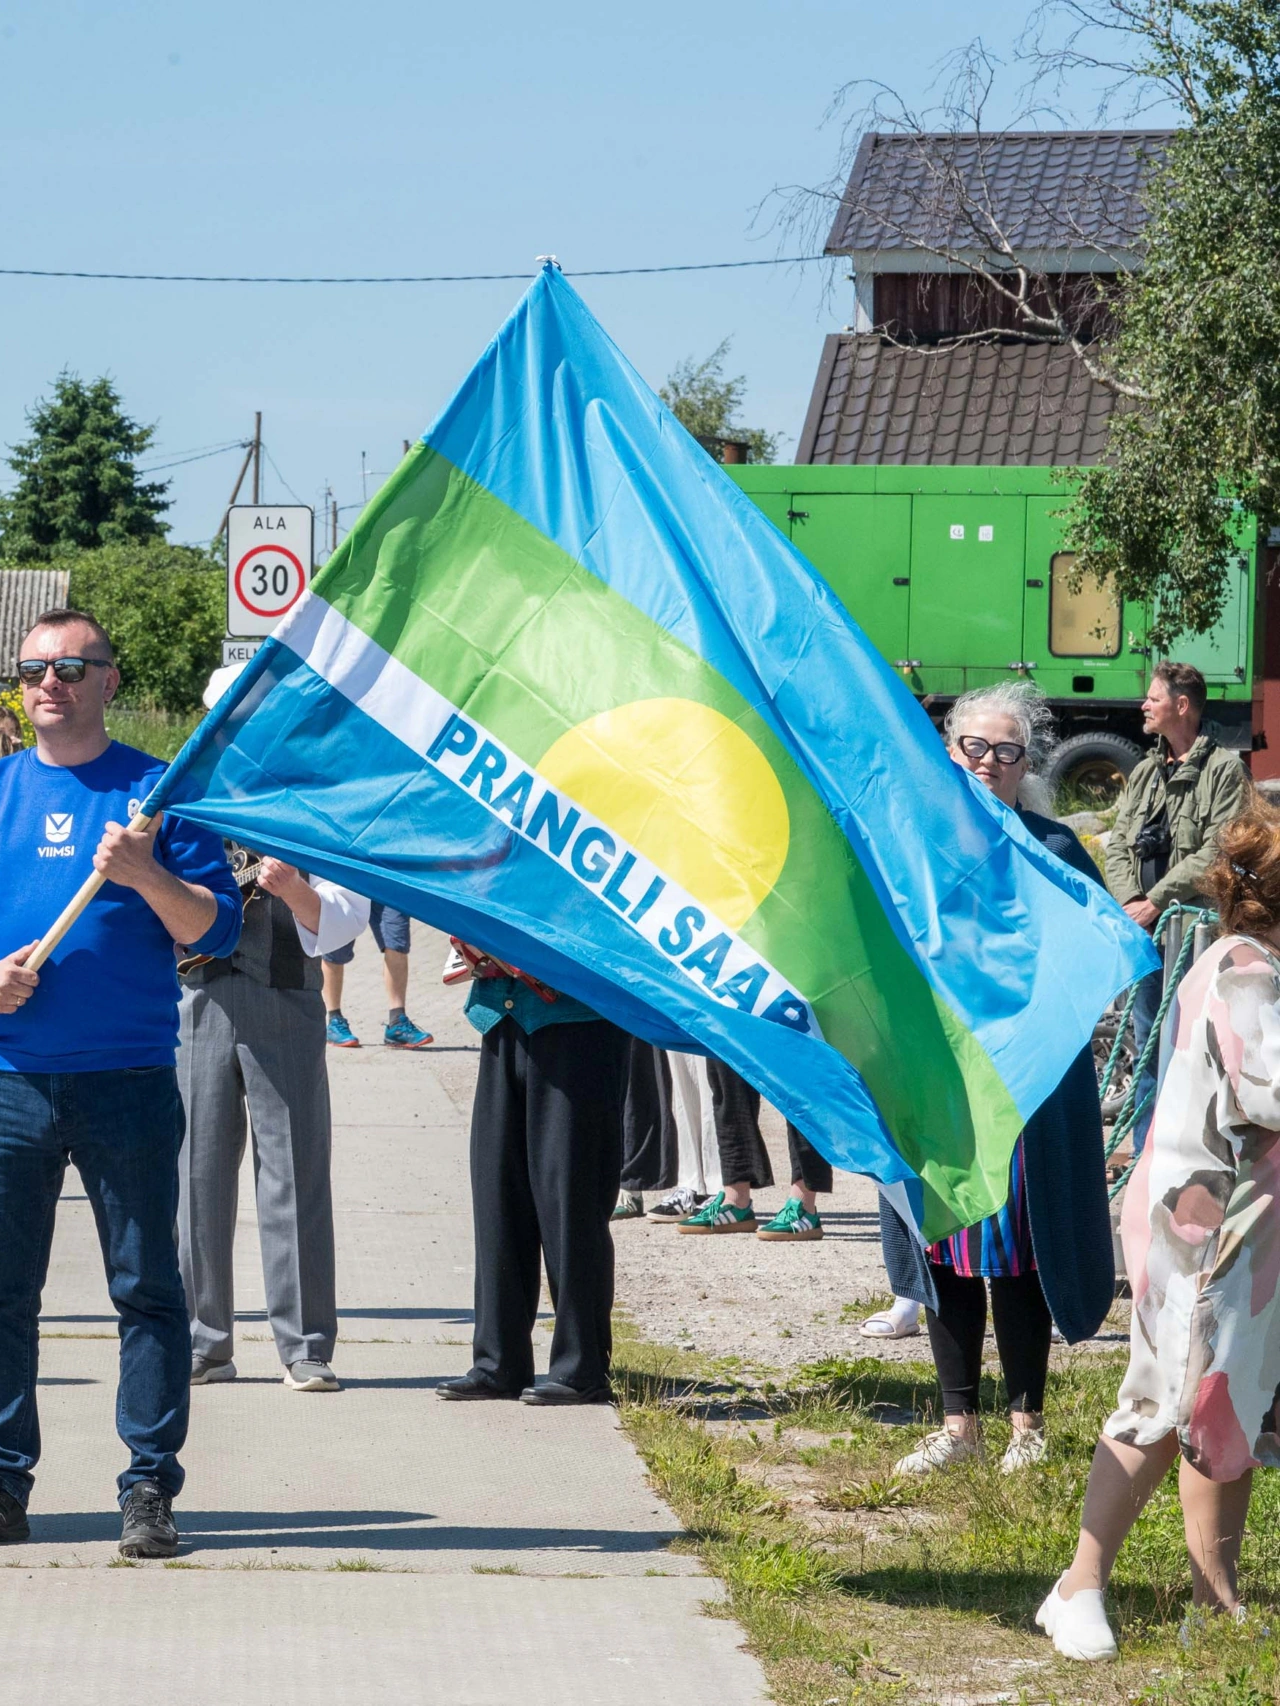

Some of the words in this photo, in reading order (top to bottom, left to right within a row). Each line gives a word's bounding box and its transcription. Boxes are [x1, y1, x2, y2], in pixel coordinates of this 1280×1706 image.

[253, 516, 287, 530] ALA
[251, 564, 289, 596] 30
[425, 713, 667, 924] PRANGLI
[37, 845, 75, 858] VIIMSI
